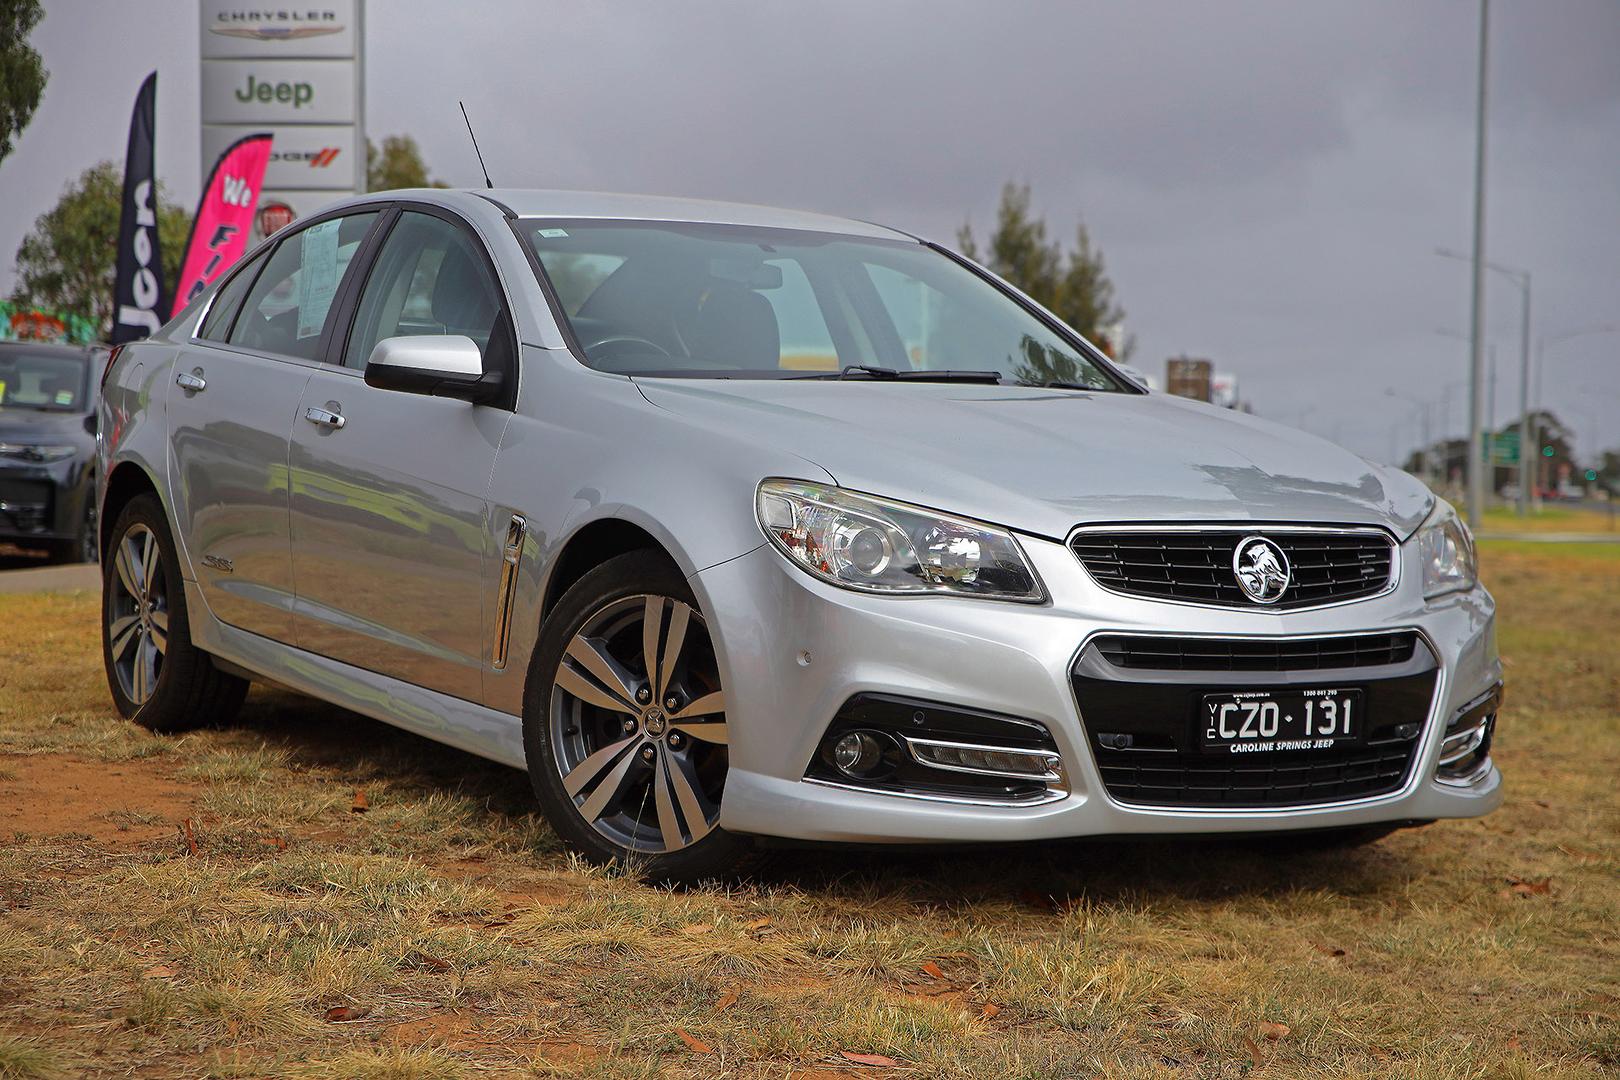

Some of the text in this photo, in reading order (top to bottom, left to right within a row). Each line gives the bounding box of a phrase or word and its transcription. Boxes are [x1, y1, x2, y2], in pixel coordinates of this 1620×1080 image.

[217, 11, 335, 21] CHRYSLER
[235, 75, 313, 108] Jeep
[223, 173, 252, 208] We
[1206, 703, 1218, 739] VIC
[1219, 699, 1351, 738] CZO 131
[1230, 739, 1334, 753] CAROLINE SPRINGS JEEP
